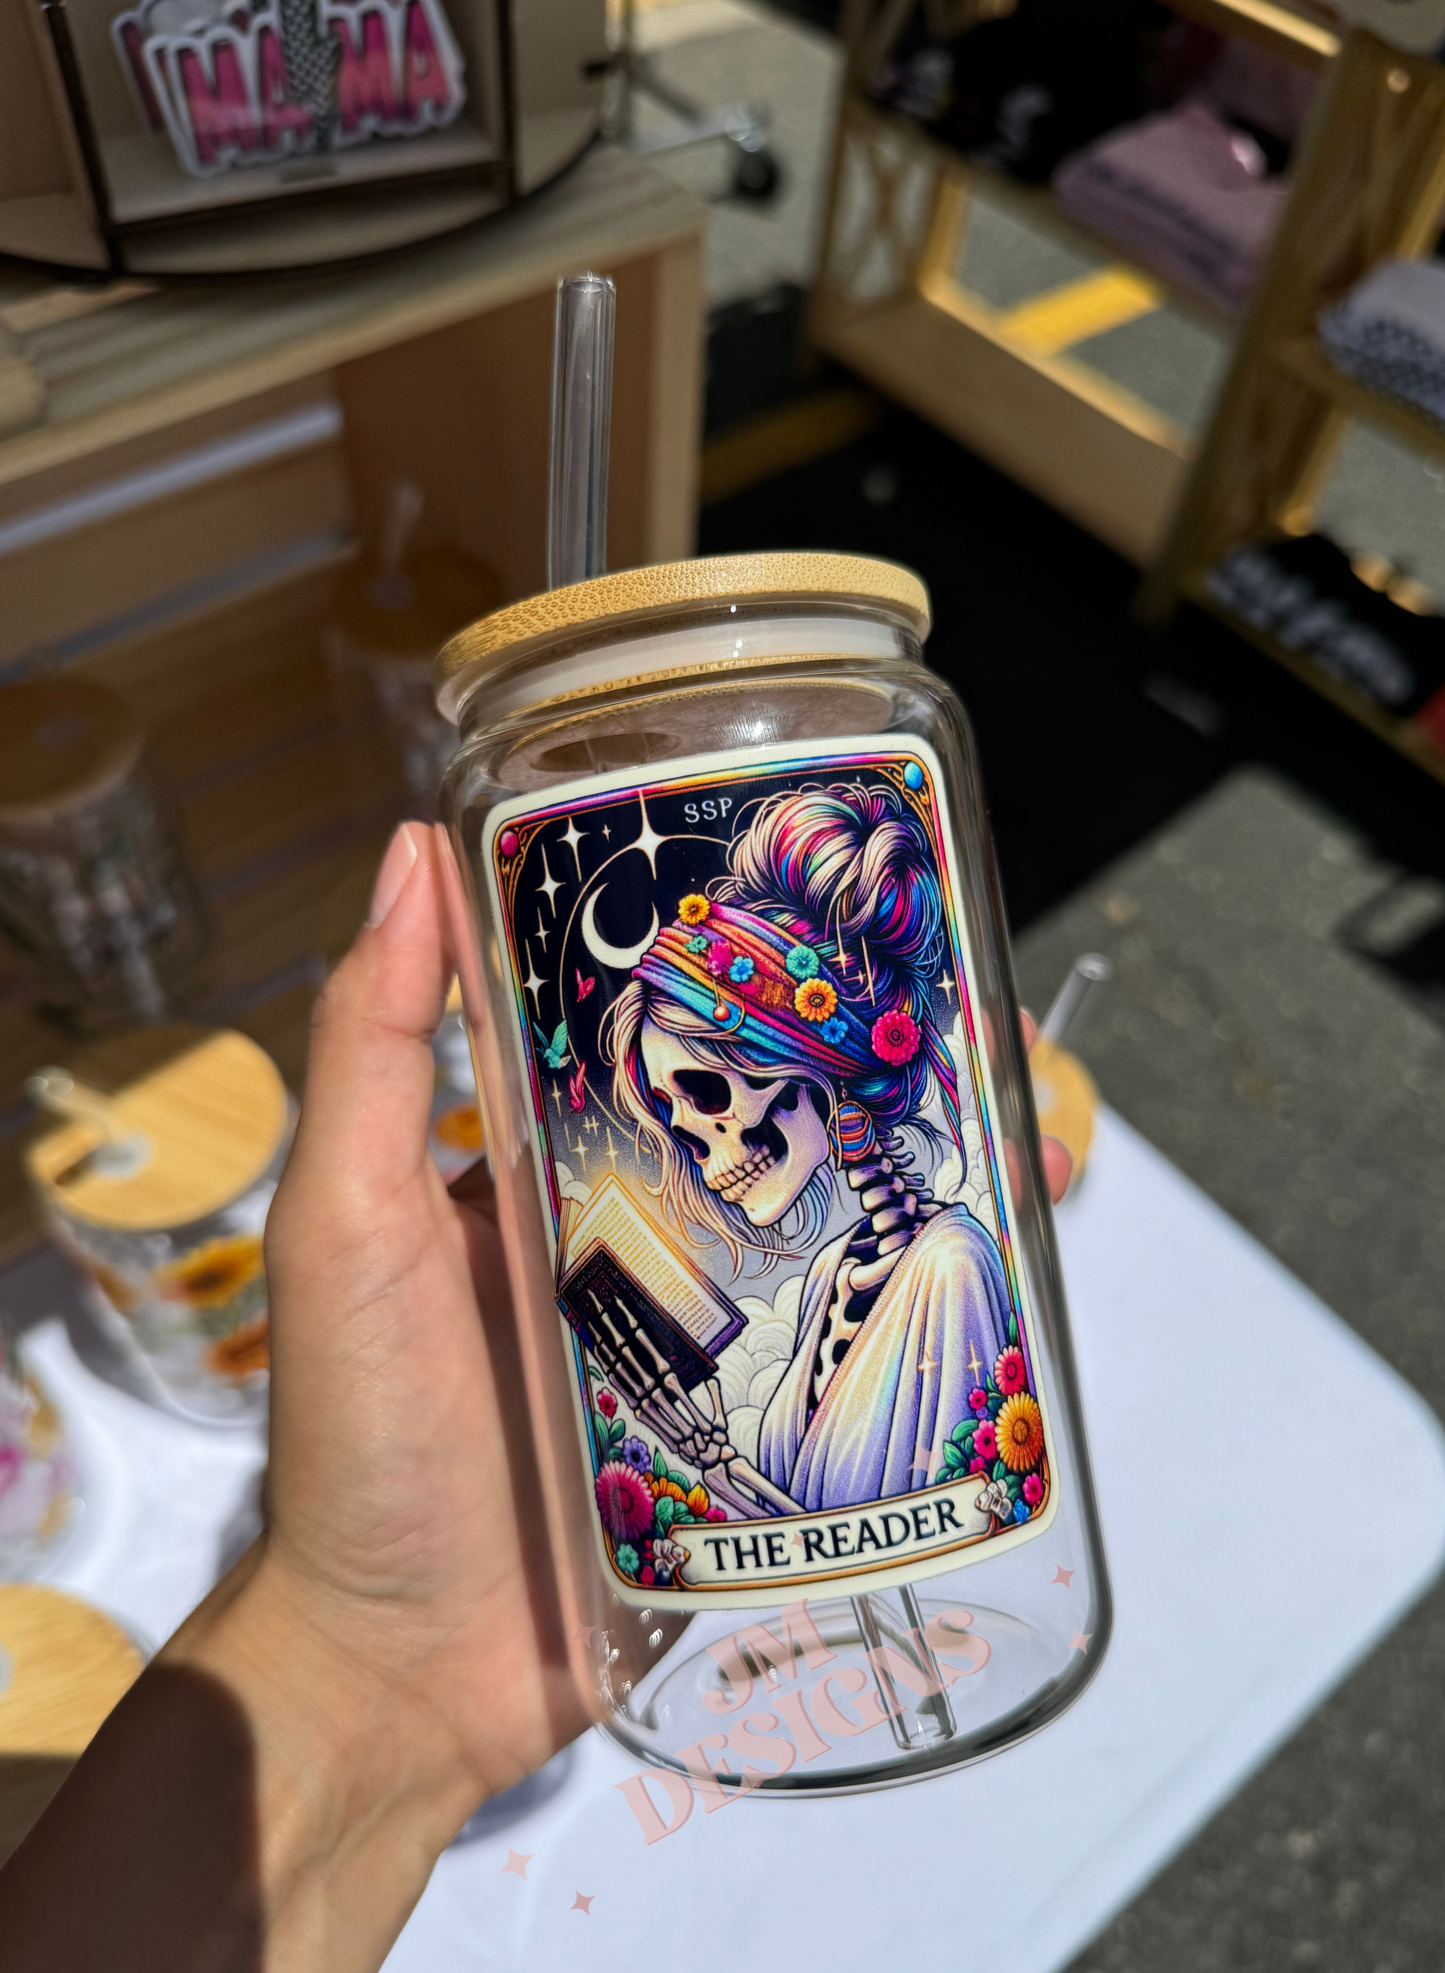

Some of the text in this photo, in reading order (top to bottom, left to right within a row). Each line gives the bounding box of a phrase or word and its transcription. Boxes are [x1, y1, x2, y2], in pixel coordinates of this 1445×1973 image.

[684, 797, 732, 823] SSP
[704, 1498, 964, 1570] THE READER
